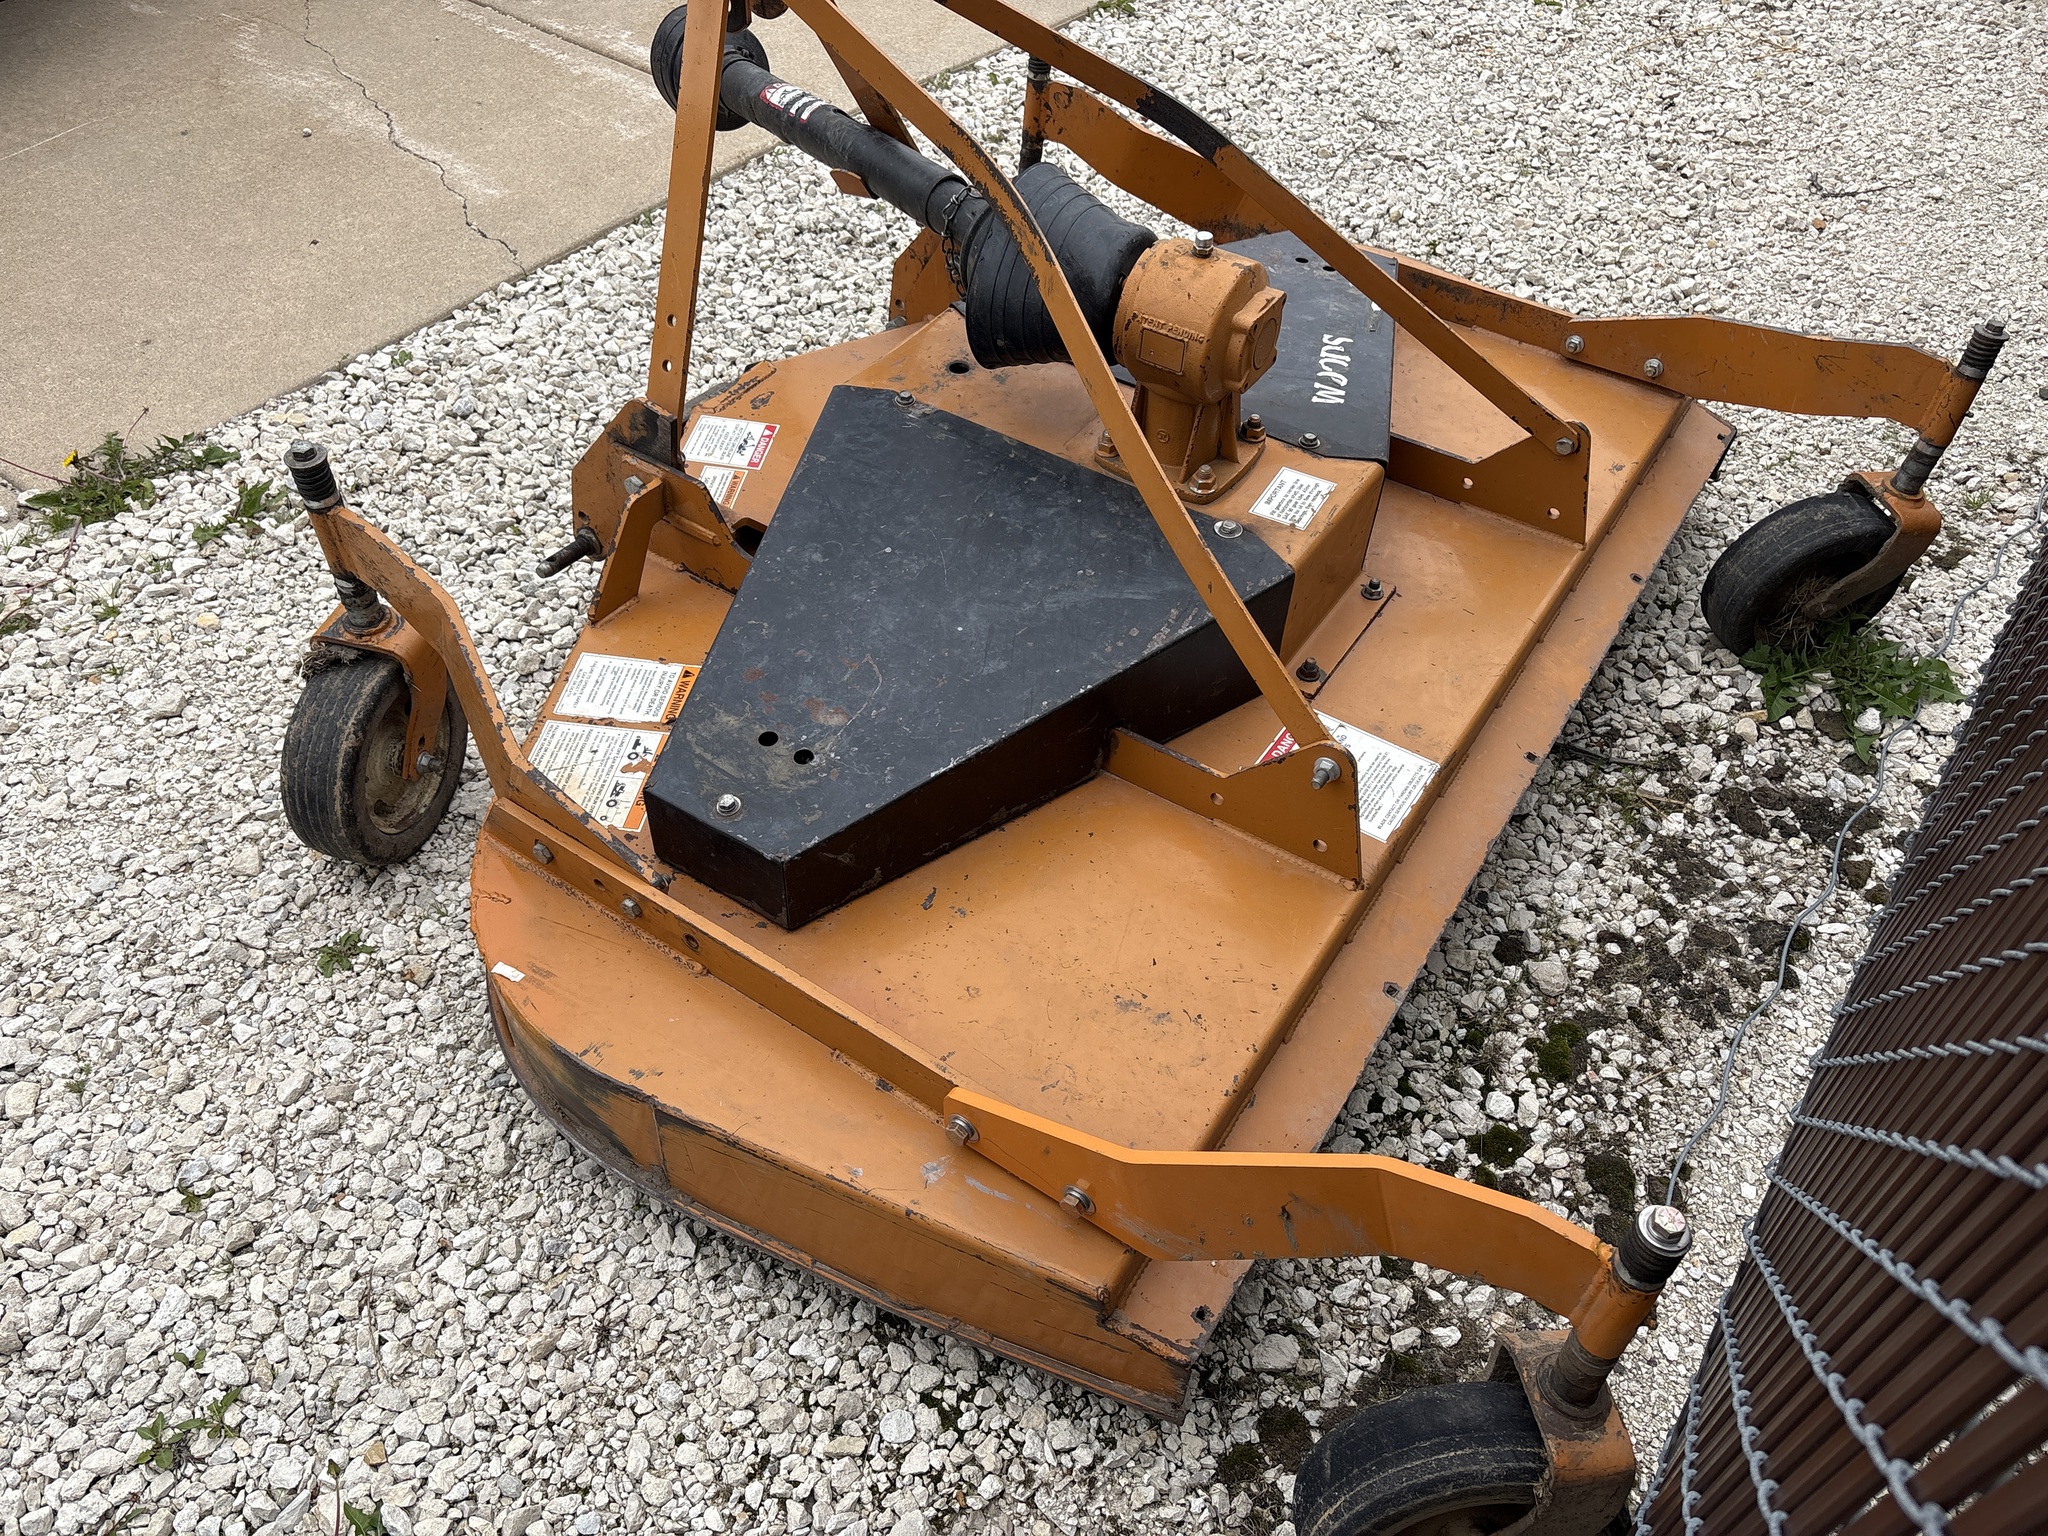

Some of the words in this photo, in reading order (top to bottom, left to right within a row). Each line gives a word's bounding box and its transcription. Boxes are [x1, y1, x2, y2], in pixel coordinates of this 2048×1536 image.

[1131, 311, 1165, 332] PATENT
[1167, 322, 1205, 343] PENDING
[751, 437, 769, 463] DANGER
[723, 481, 738, 505] WARNING
[1264, 480, 1286, 505] IMPORTANT
[656, 671, 668, 688] INJURY
[662, 679, 673, 694] AVOID
[652, 689, 660, 697] OR
[665, 681, 690, 720] WARNING
[652, 695, 666, 717] SERIOUS
[619, 733, 629, 747] FALLING
[1271, 732, 1294, 758] DANG
[574, 743, 586, 763] EQUIPMENT
[605, 764, 614, 778] RESULT
[596, 784, 605, 795] BEING
[1377, 818, 1387, 829] BLADE
[1385, 804, 1396, 818] CONTACT
[1398, 786, 1409, 798] THROWN
[1408, 772, 1419, 785] OBJECTS
[587, 806, 595, 815] OVE
[1387, 814, 1397, 825] CAUSE
[1395, 801, 1406, 814] SERIOUS
[1404, 790, 1413, 801] INJURY
